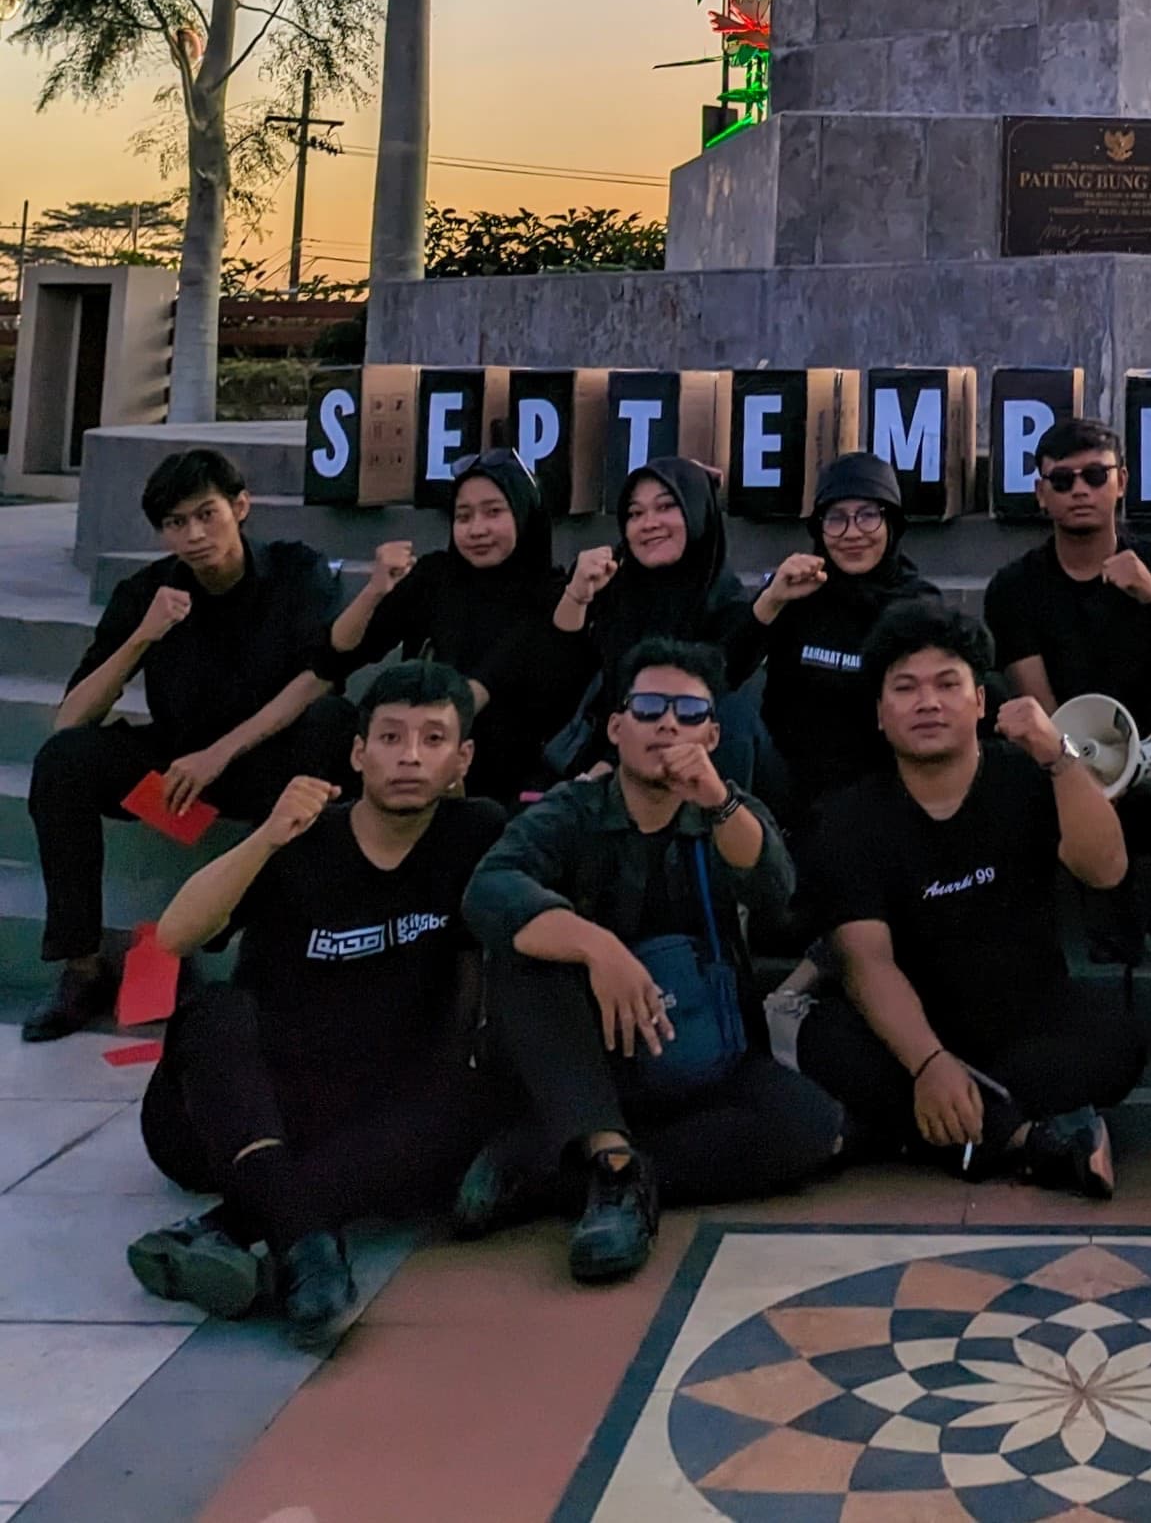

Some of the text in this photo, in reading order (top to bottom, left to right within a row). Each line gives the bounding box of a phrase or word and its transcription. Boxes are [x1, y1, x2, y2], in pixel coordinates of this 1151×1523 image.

[1019, 172, 1092, 189] PATUNG
[1097, 173, 1149, 190] BUNG
[975, 867, 995, 884] 99
